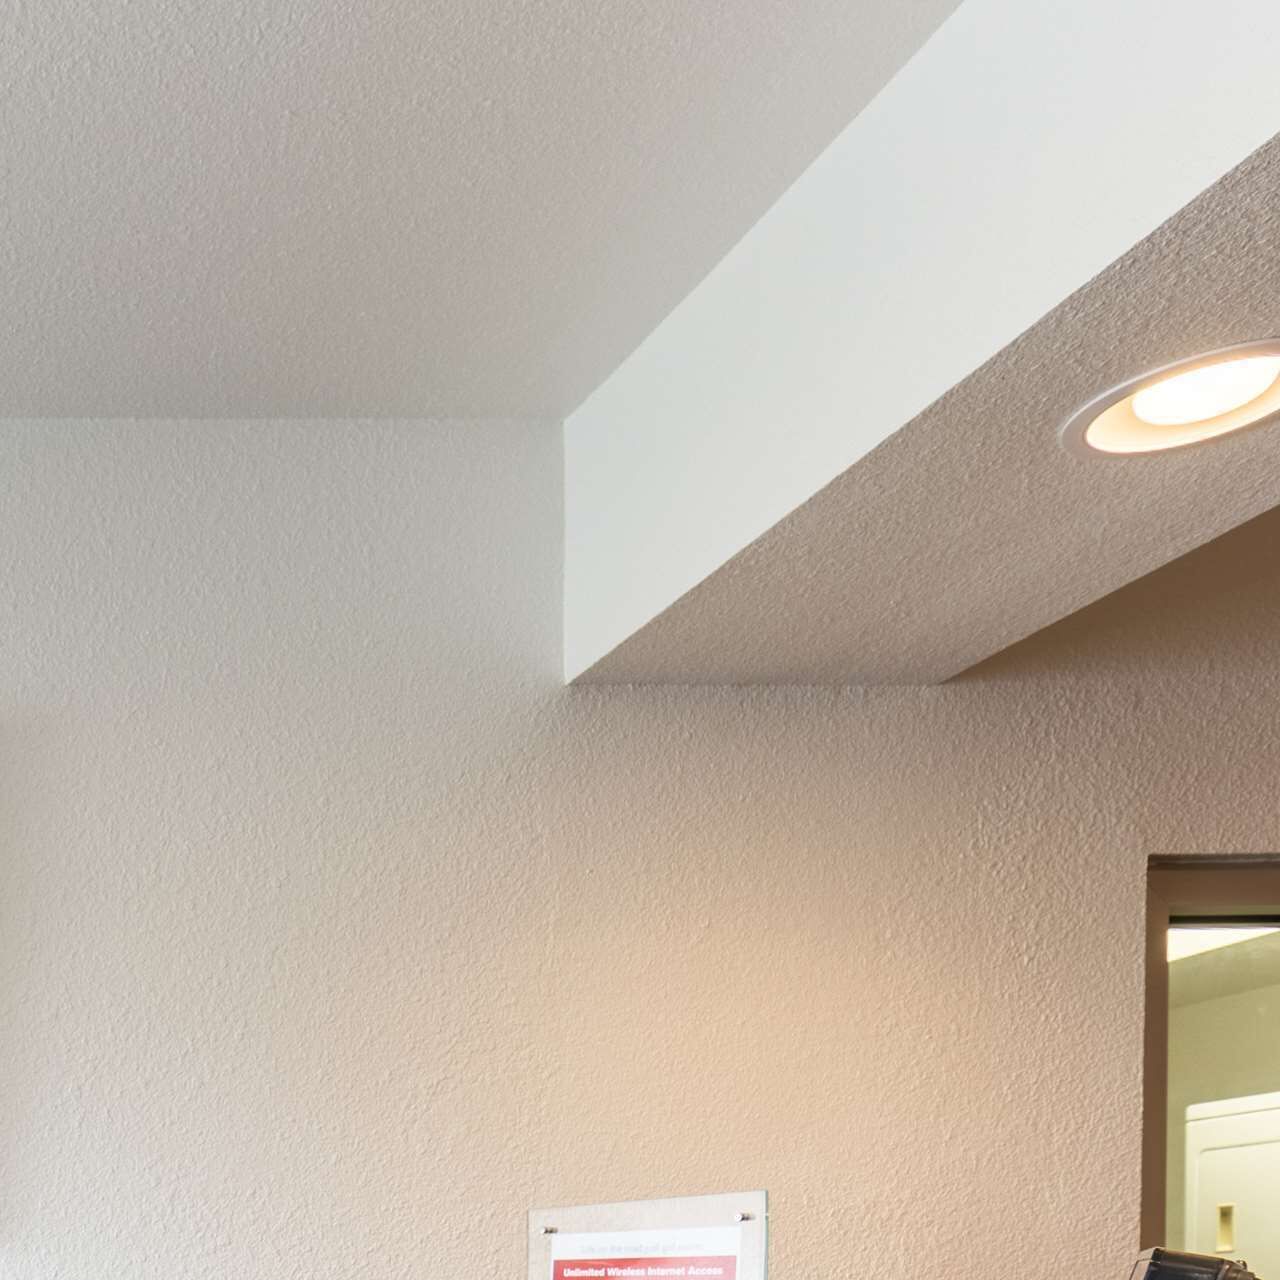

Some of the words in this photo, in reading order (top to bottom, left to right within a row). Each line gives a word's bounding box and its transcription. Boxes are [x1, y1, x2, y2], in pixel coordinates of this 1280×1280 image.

[563, 1266, 605, 1278] Unlimited
[607, 1266, 646, 1277] Wireless
[648, 1266, 685, 1277] Internet
[688, 1266, 724, 1276] Access
